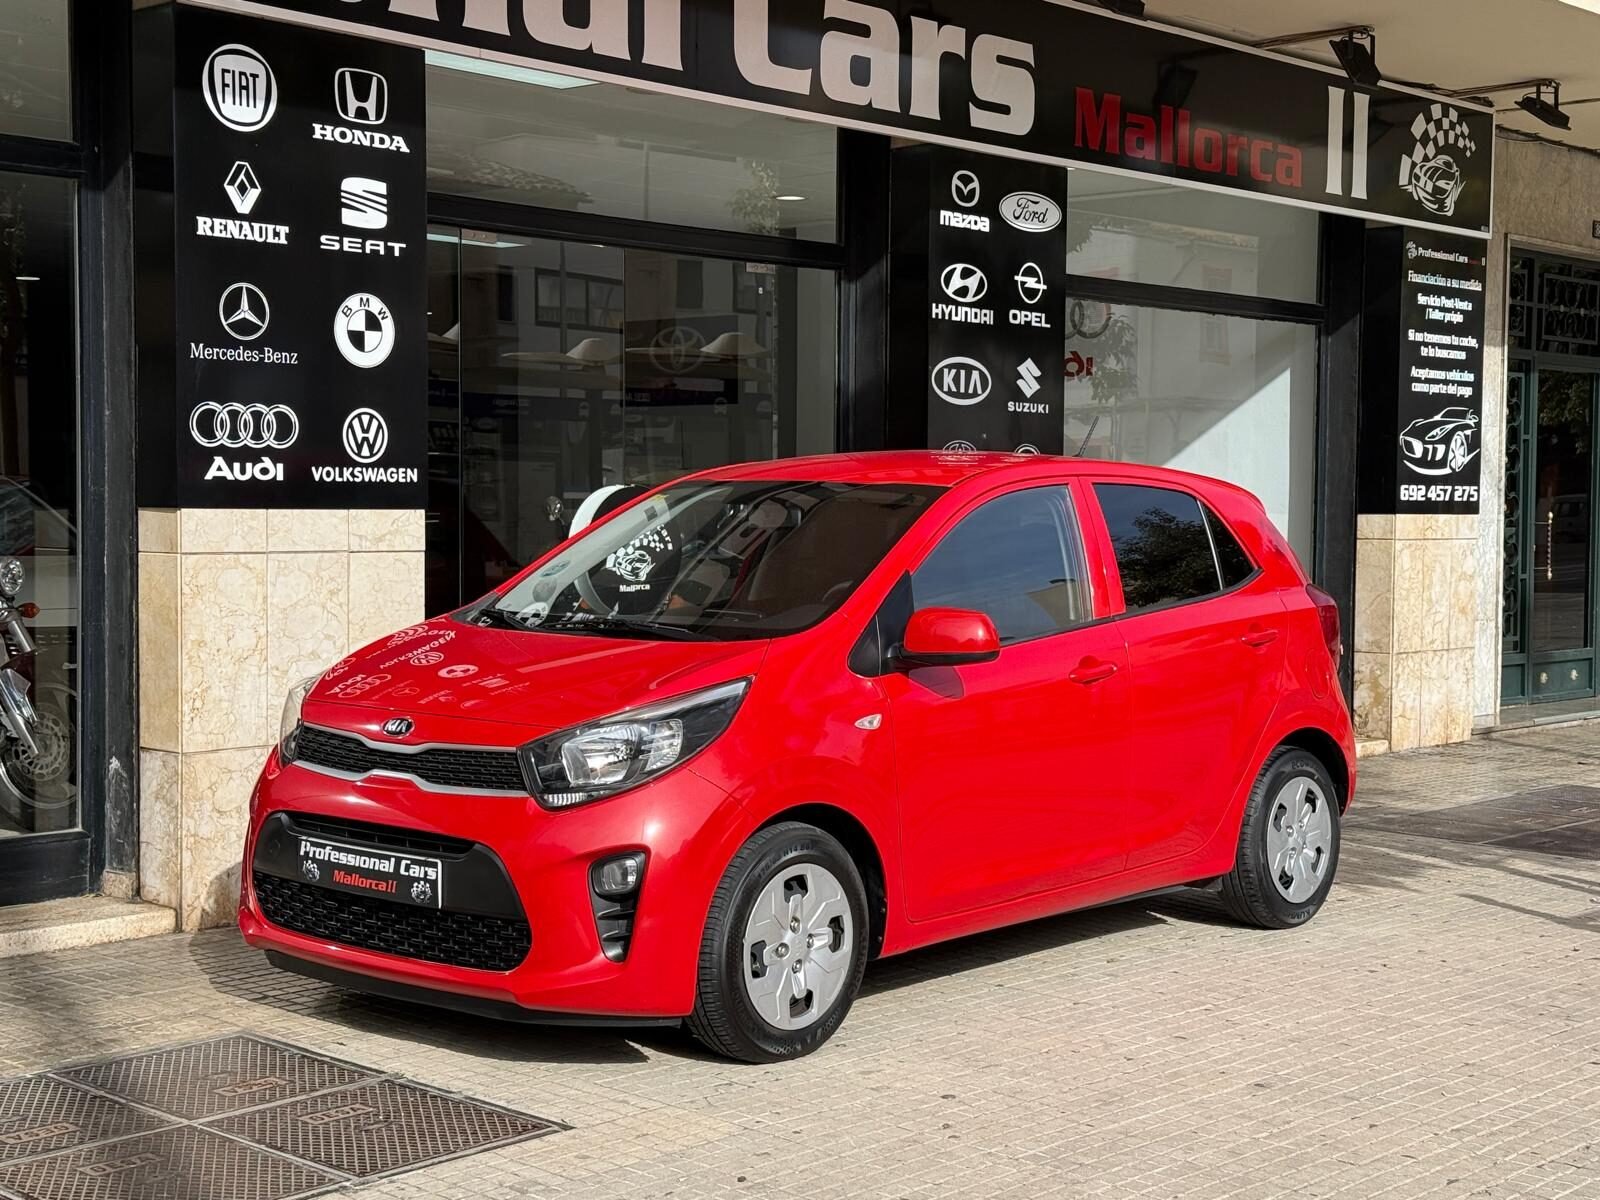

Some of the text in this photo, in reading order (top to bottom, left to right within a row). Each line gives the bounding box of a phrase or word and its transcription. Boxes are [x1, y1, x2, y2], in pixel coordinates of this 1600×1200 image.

[734, 0, 1035, 136] Cars
[220, 67, 260, 109] FIAT
[312, 122, 411, 154] HONDA
[1074, 86, 1303, 188] Mallorca
[1012, 196, 1050, 225] Ford
[195, 215, 290, 246] RENAULT
[319, 234, 407, 257] SEAT
[1418, 246, 1456, 262] Professional
[341, 296, 389, 322] BMW
[1417, 292, 1441, 307] Servicio
[931, 302, 994, 325] HYUNDAI
[1008, 309, 1052, 328] OPEL
[189, 342, 299, 365] Mercedes-Benz
[1435, 345, 1467, 360] buscamos
[942, 367, 983, 396] KIA
[1410, 365, 1446, 381] Aceptamos
[1007, 401, 1050, 415] SUZUKI
[204, 455, 284, 481] Audi
[311, 465, 419, 483] VOLKSWAGEN
[1400, 484, 1479, 502] 692 457 275
[384, 718, 409, 733] KIA
[299, 840, 438, 880] Professional Cars
